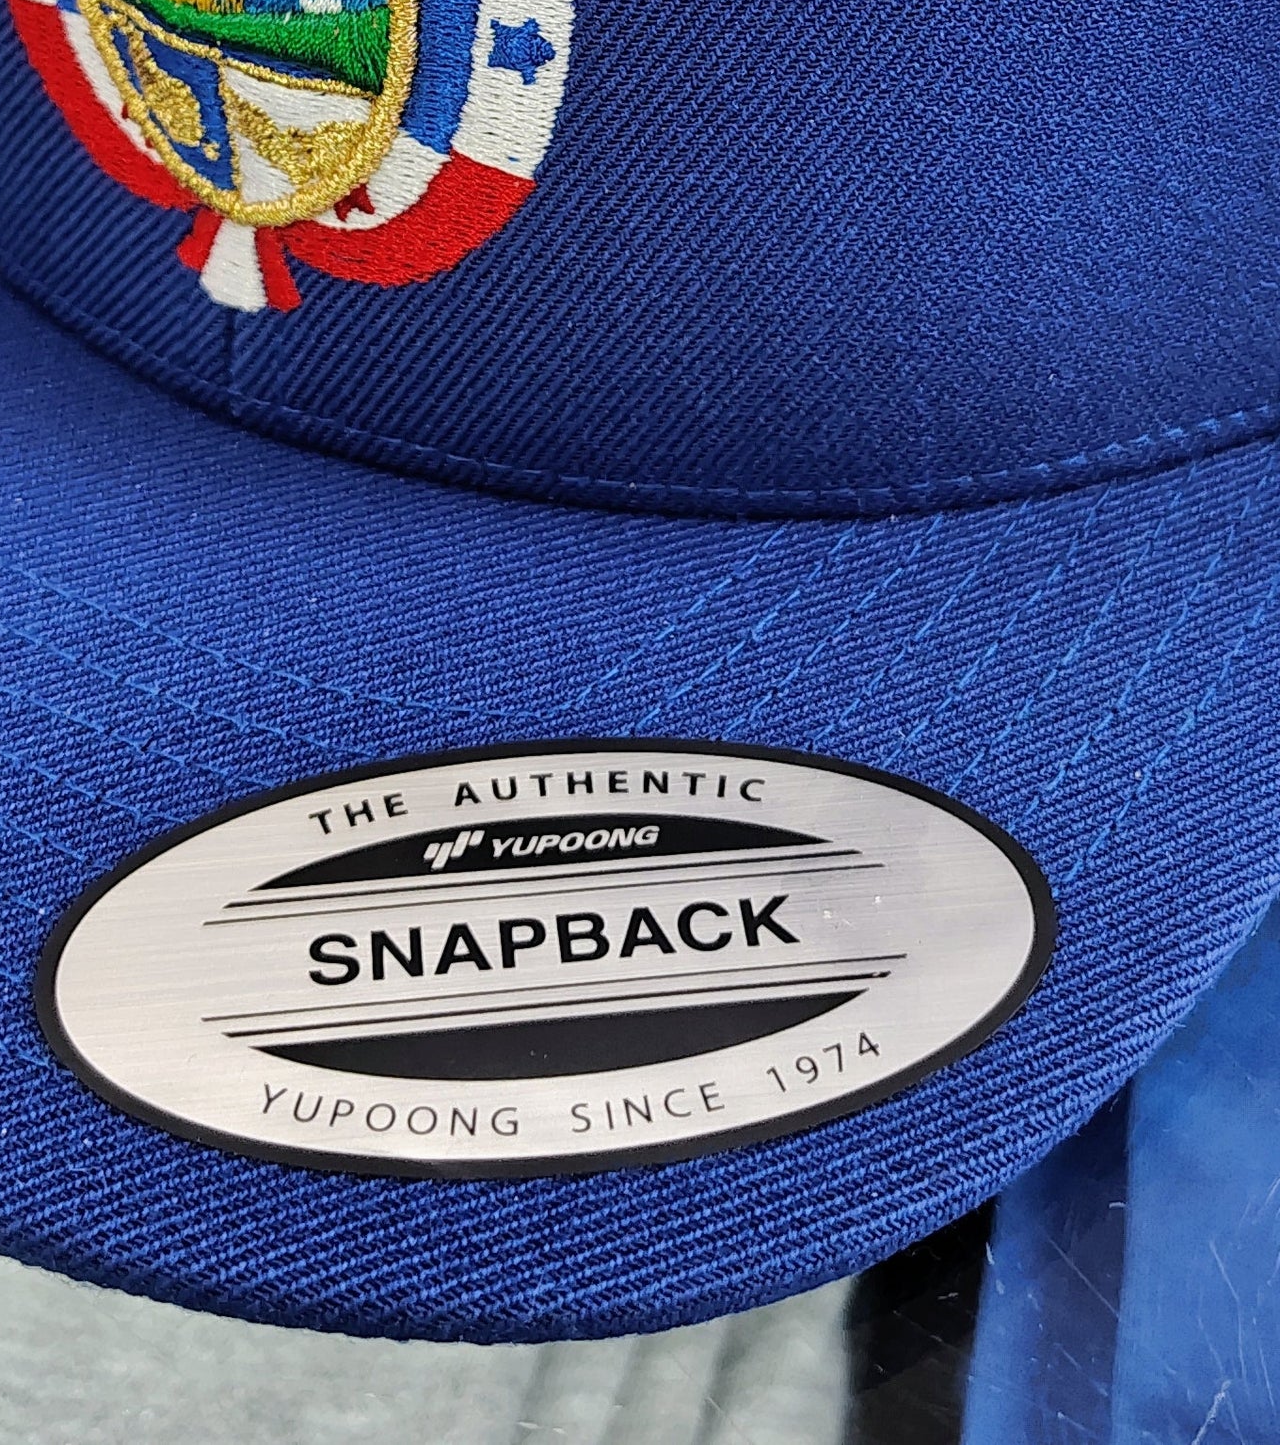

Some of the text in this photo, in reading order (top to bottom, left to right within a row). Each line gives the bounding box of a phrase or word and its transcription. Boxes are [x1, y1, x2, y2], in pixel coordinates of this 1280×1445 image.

[308, 770, 767, 837] THE AUTHENTIC
[491, 825, 661, 859] YUPOONG
[308, 894, 802, 987] SNAPBACK
[261, 1030, 883, 1138] YUPOONG SINCE 1974
